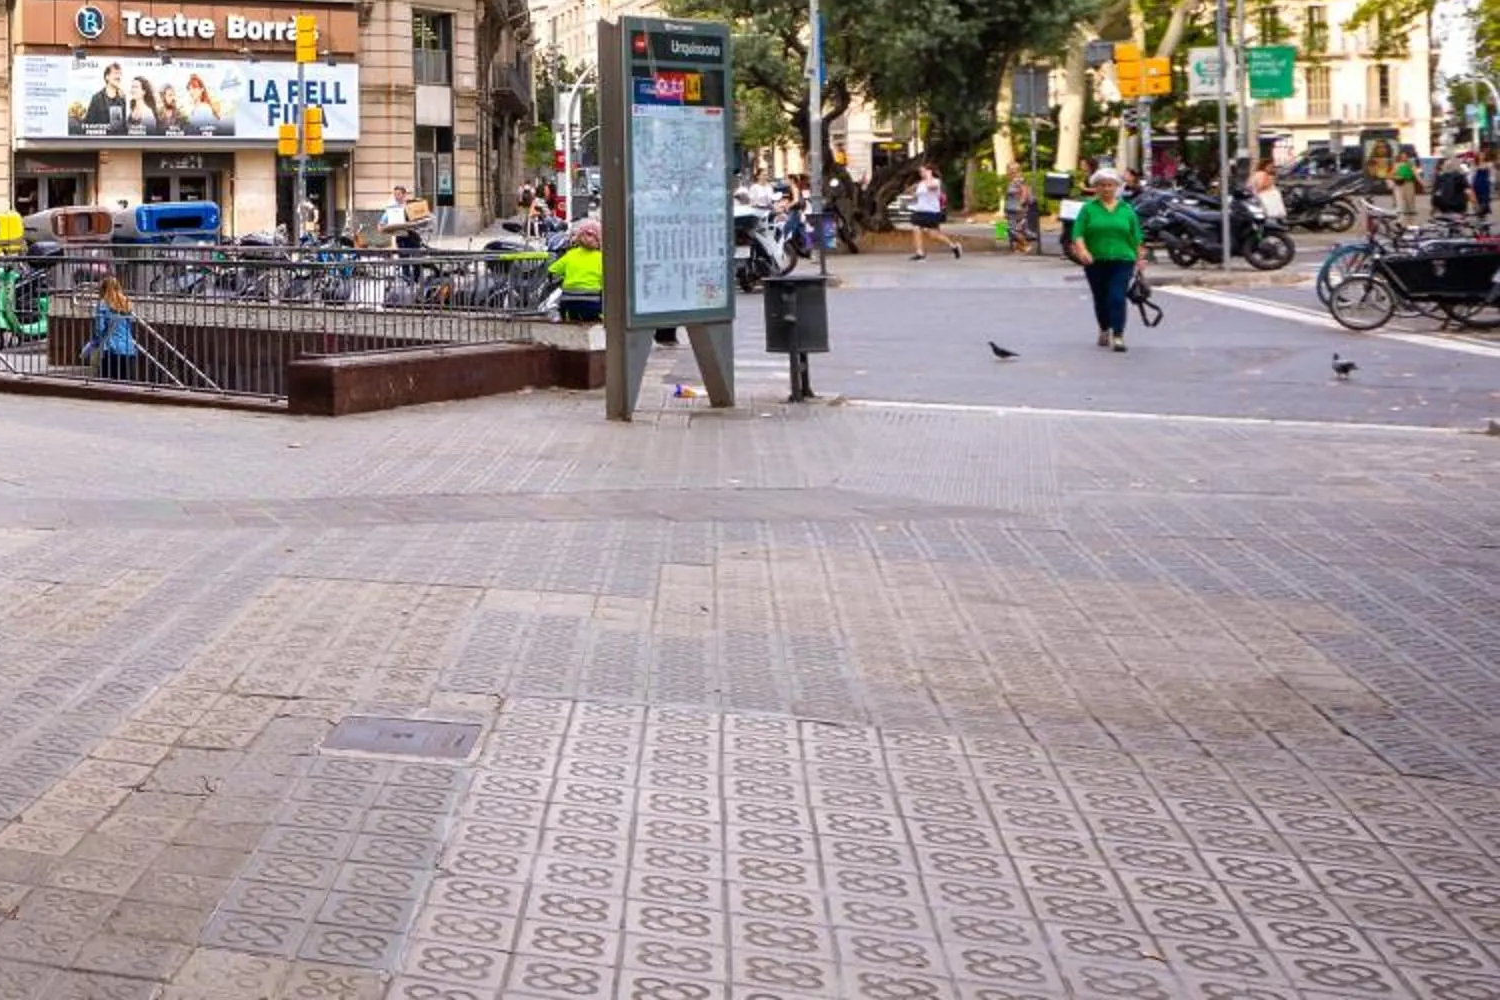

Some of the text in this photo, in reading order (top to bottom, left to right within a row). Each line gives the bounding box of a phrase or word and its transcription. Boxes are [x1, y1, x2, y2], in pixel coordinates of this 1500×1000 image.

[121, 10, 319, 41] Teatre Borrà
[249, 79, 347, 105] LA PELL
